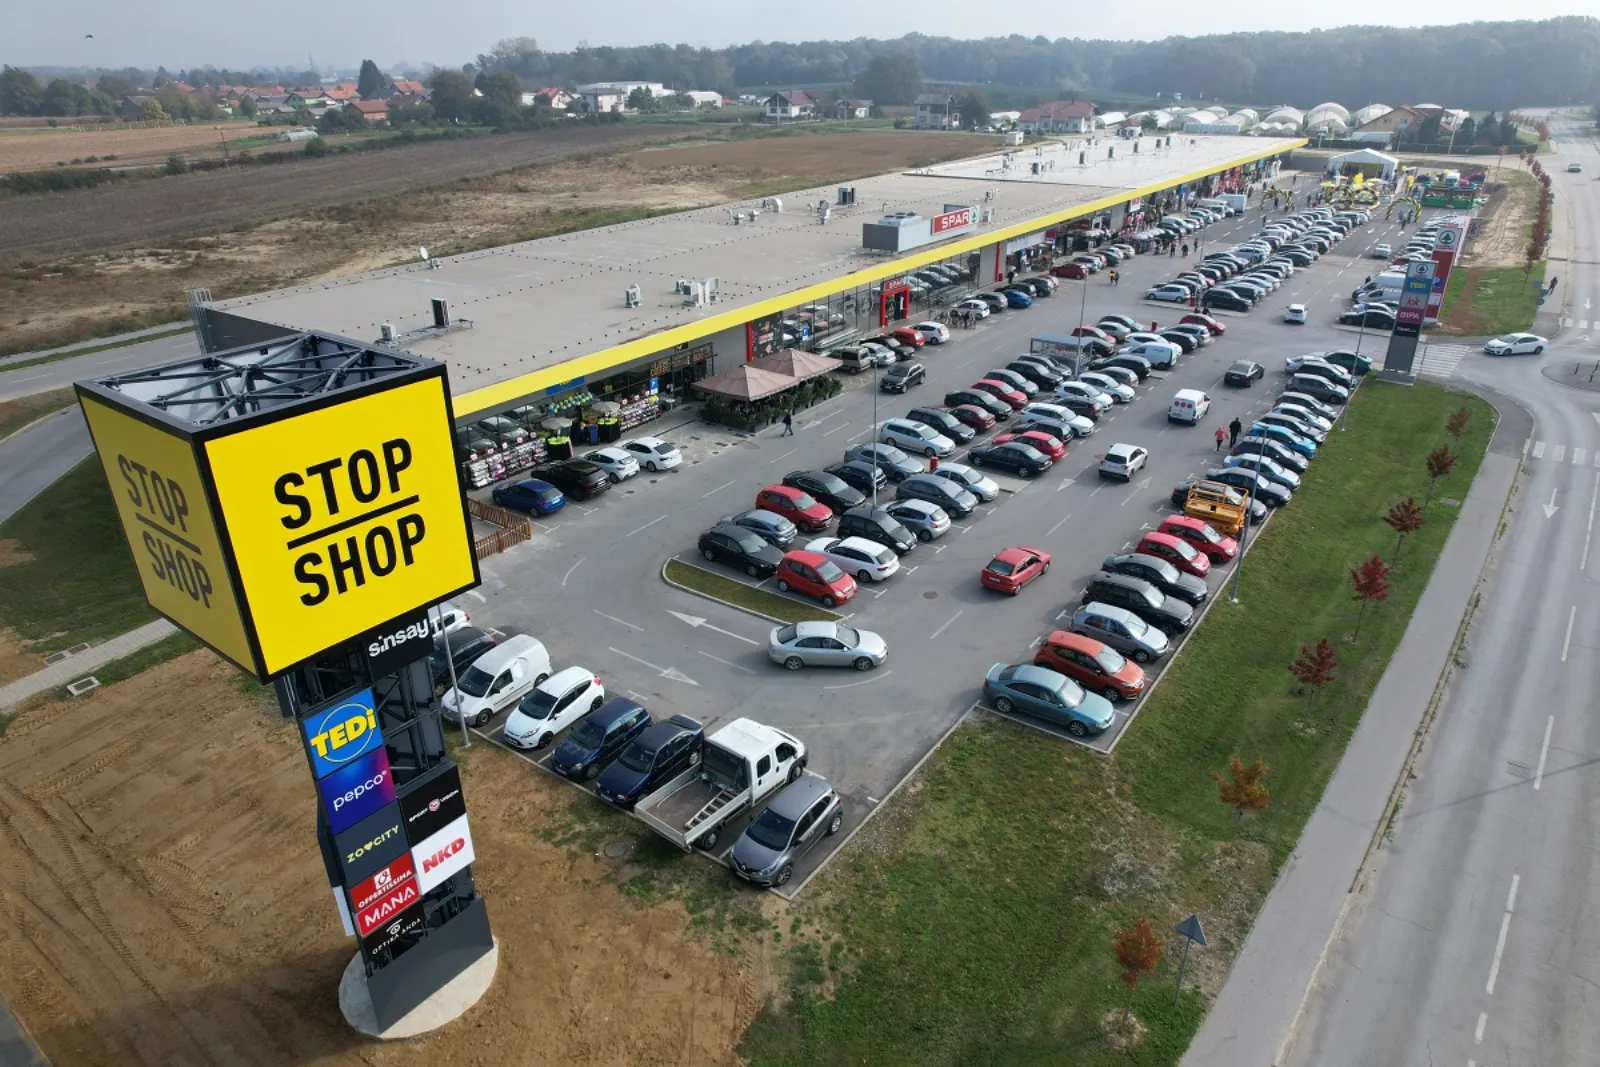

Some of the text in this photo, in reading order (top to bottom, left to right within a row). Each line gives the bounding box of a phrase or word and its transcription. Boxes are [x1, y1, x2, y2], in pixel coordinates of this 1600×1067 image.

[941, 210, 969, 229] SPAR
[1400, 311, 1420, 320] BIPA
[117, 453, 189, 533] STOP
[274, 438, 413, 529] STOP
[142, 529, 213, 609] SHOP
[293, 512, 426, 606] SHOP
[368, 618, 430, 657] sinsay
[310, 708, 377, 758] TEDi
[333, 773, 384, 812] pepco
[422, 837, 465, 874] NKD
[358, 869, 413, 909] OFFERTISSIMA
[364, 886, 416, 928] MANA
[372, 918, 422, 956] OPTIKA ANDA
